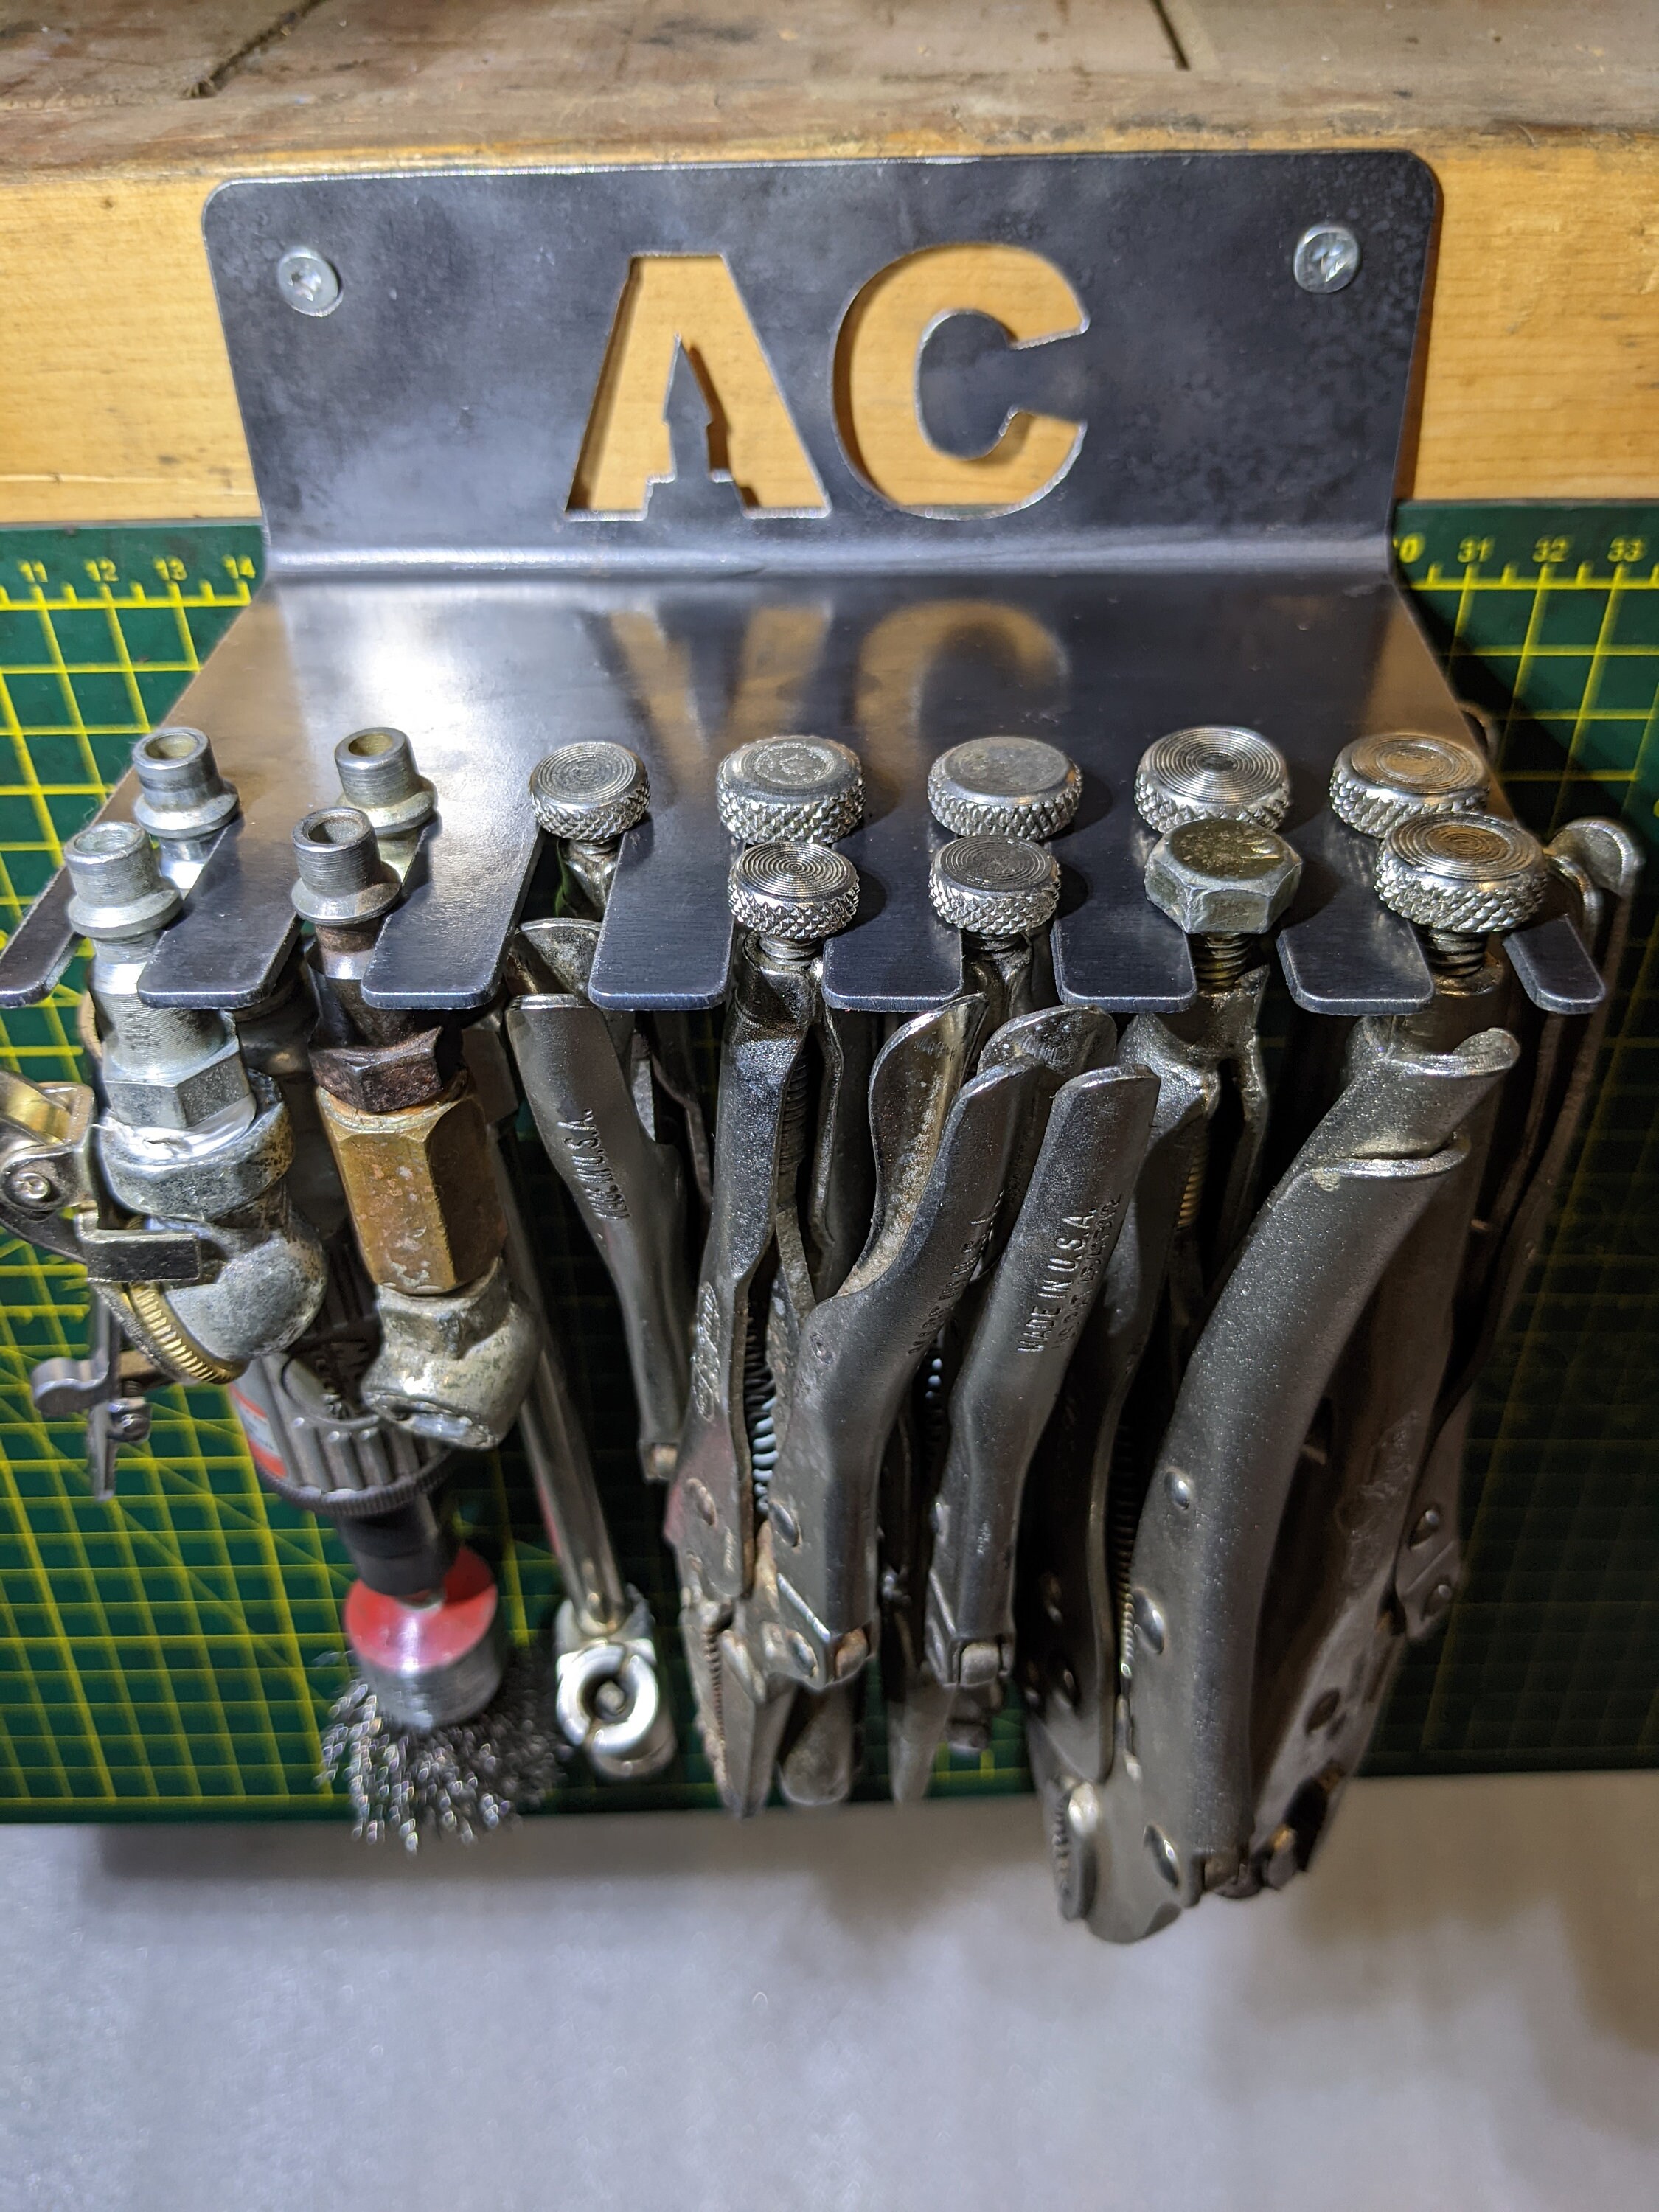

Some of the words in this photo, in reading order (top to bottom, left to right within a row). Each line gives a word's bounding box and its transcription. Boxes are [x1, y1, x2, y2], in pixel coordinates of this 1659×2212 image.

[563, 240, 1089, 521] AC
[1392, 532, 1425, 563] 0
[1457, 535, 1496, 563] 31
[1532, 535, 1573, 563] 32
[1607, 536, 1647, 563] 33
[17, 559, 48, 583] 11
[83, 557, 119, 582] 12
[153, 555, 187, 581] 13
[223, 554, 256, 579] 14
[1047, 1208, 1098, 1272] U.S.A.
[1037, 1279, 1074, 1298] IN
[1017, 1305, 1062, 1352] MADE
